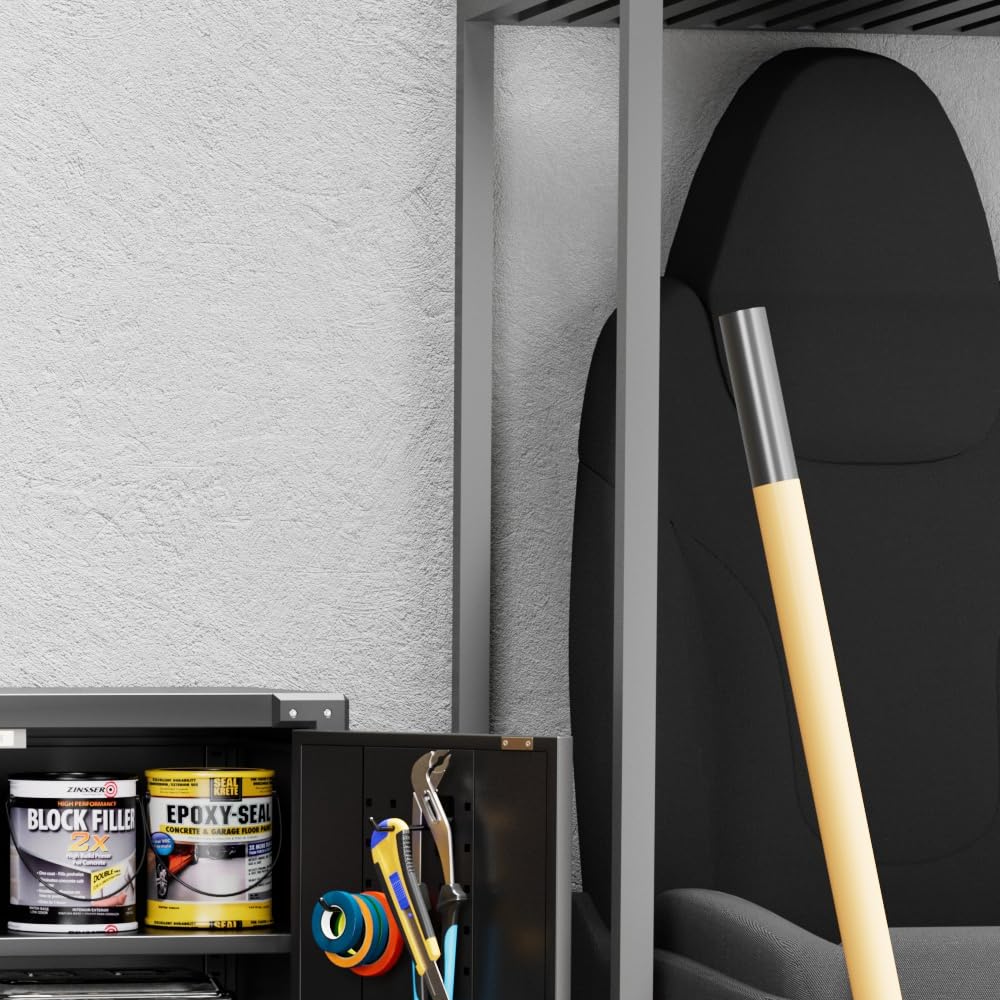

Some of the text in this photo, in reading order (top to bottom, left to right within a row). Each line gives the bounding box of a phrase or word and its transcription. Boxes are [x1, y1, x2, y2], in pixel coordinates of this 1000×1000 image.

[214, 778, 238, 787] SEAL
[214, 787, 239, 796] KRETE
[27, 808, 135, 831] BLOCK FILLER
[167, 803, 271, 825] EPOXY-SEAL
[166, 826, 201, 835] CONCRETE
[211, 826, 240, 835] GARAGE
[241, 825, 259, 834] FLOOR
[93, 869, 114, 883] DOUBLE
